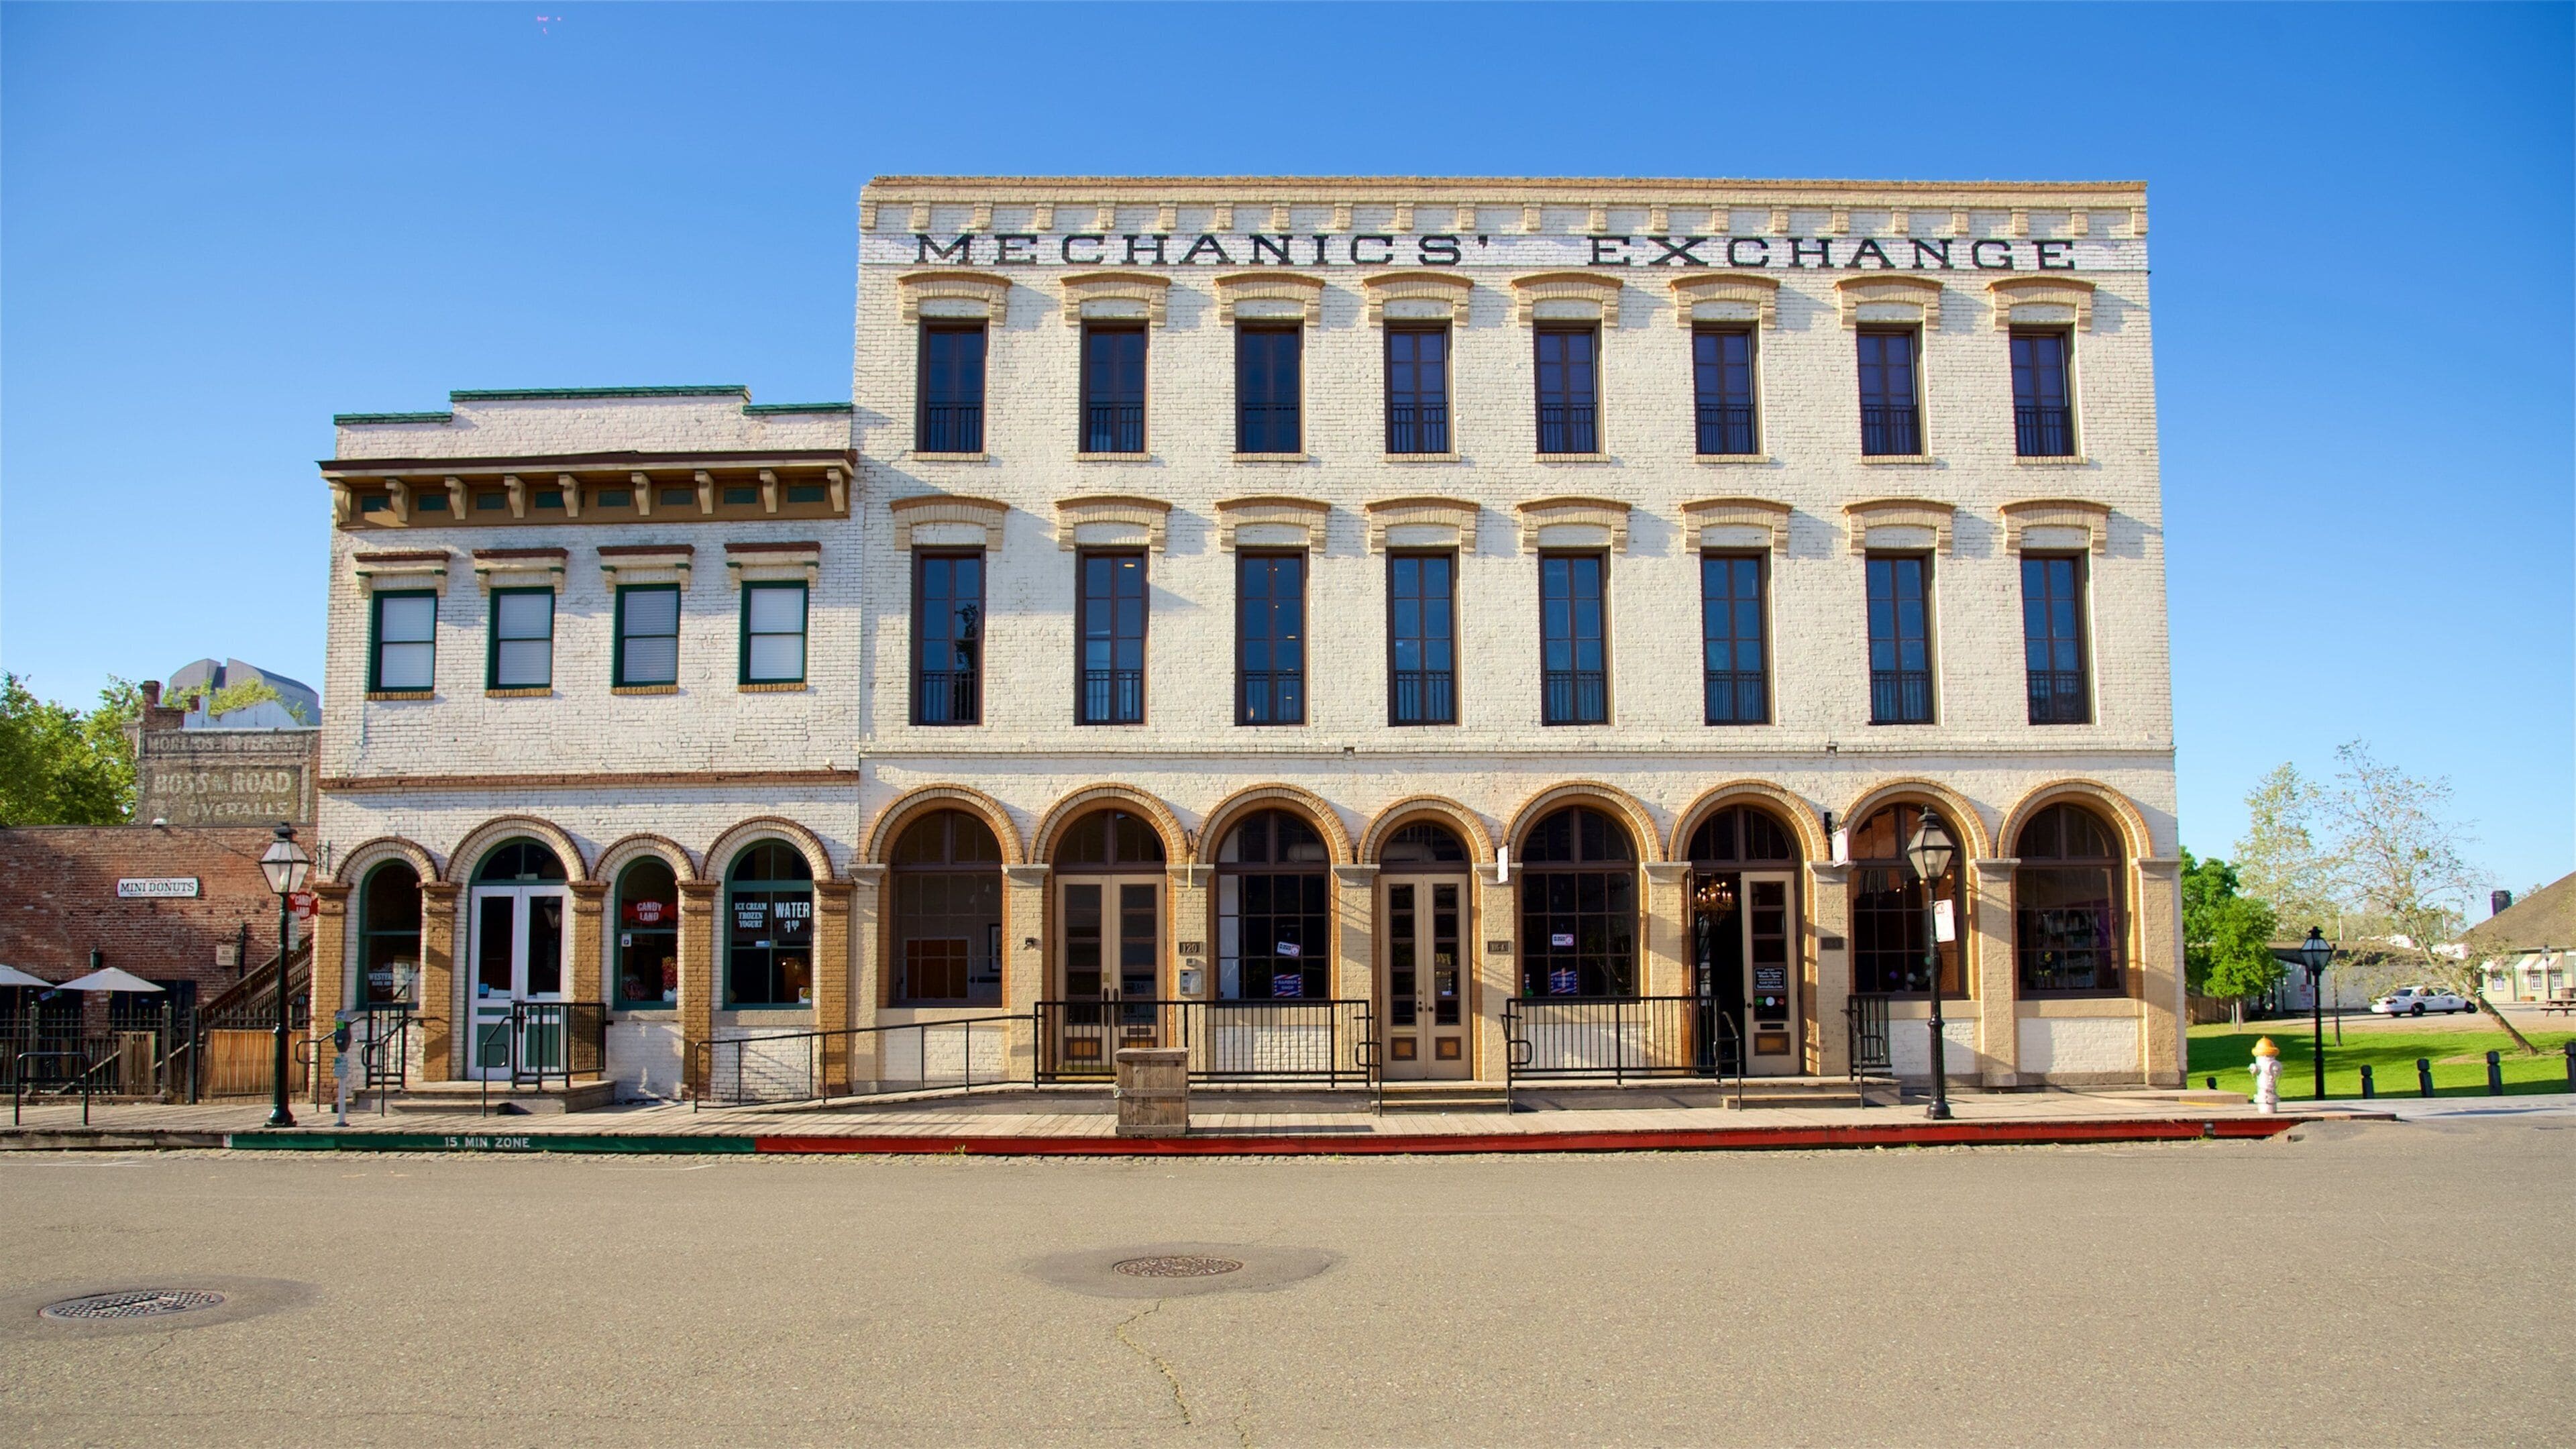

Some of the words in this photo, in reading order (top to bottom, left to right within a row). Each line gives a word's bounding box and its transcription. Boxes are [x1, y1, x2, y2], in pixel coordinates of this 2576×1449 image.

[914, 233, 1490, 266] MECHANICS'
[1587, 236, 2076, 269] EXCHANGE
[154, 773, 209, 794] BOSS
[231, 771, 291, 793] ROAD
[186, 802, 289, 816] OVERALLS
[121, 883, 146, 892] MINI
[149, 882, 195, 892] DONUTS
[637, 902, 663, 912] CANDY
[735, 902, 745, 910] ICE
[746, 902, 767, 910] CREAM
[775, 902, 810, 918] WATER
[639, 912, 659, 921] LAND
[739, 920, 763, 928] YOGURT
[1183, 943, 1197, 953] 120
[444, 1136, 458, 1147] 15
[464, 1136, 488, 1148] MIN
[494, 1137, 530, 1148] ZONE
